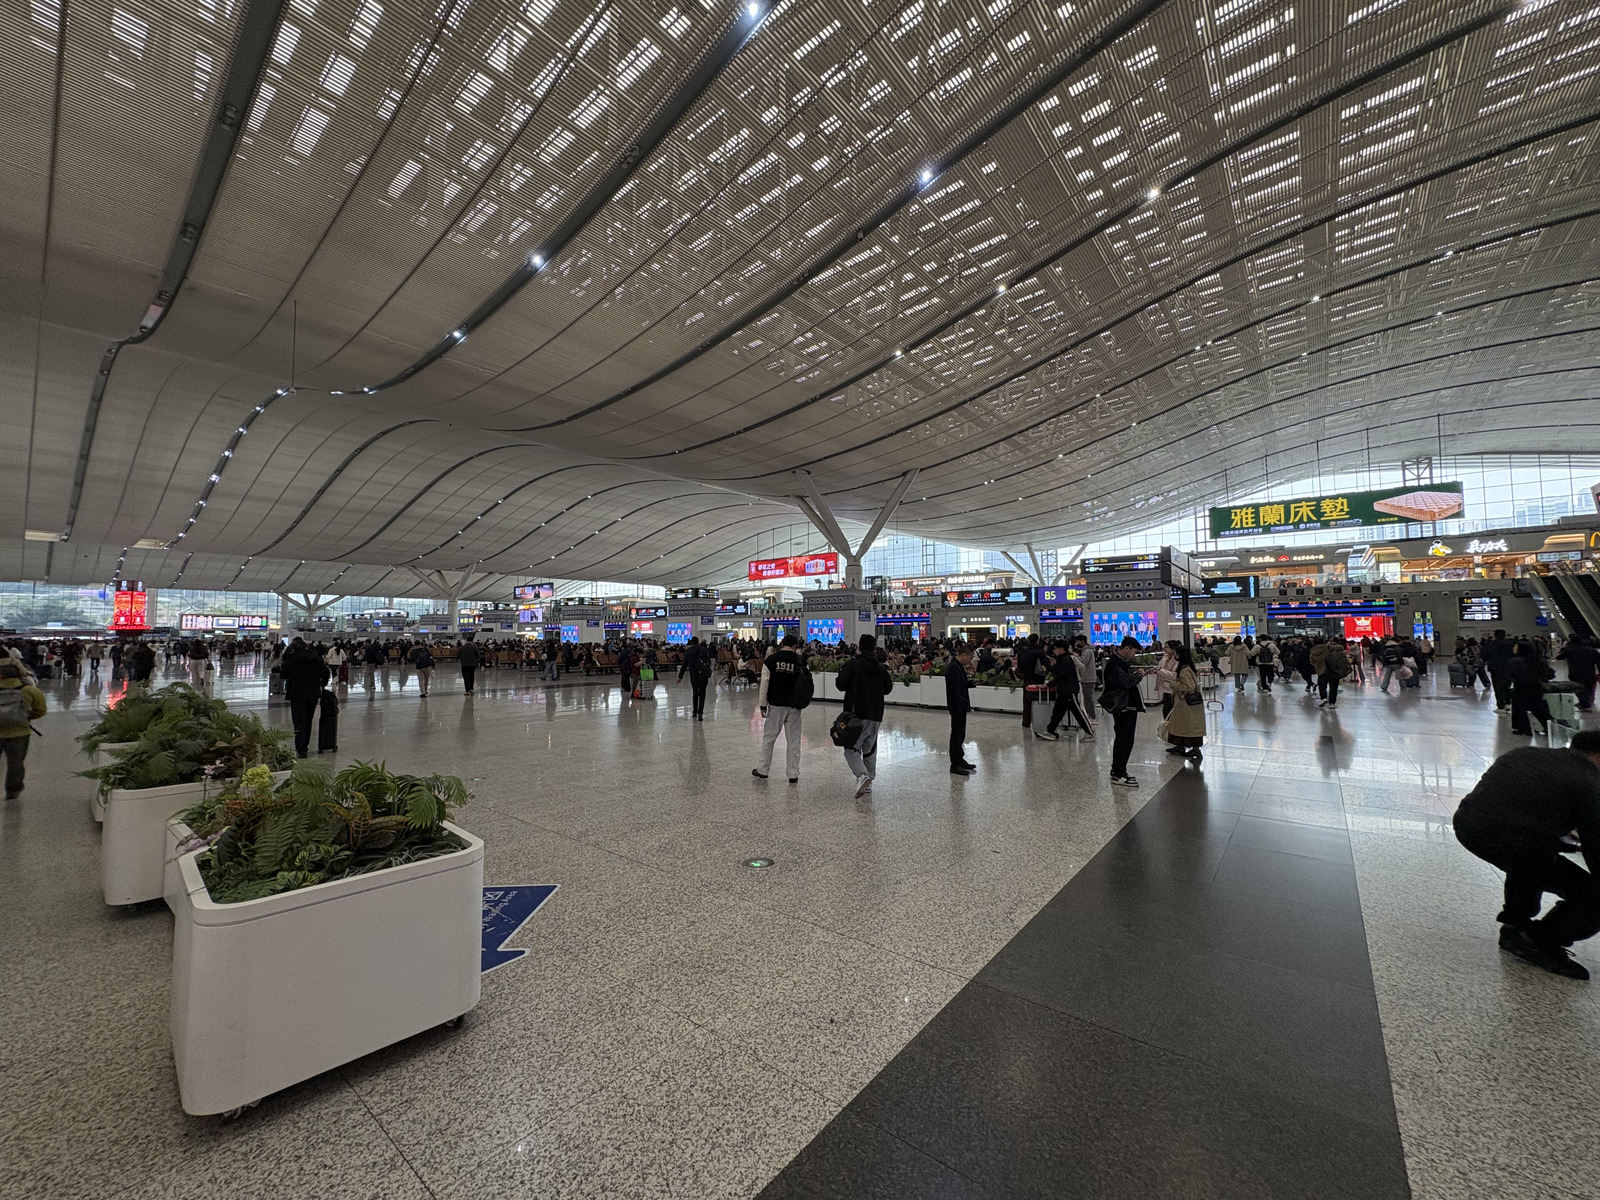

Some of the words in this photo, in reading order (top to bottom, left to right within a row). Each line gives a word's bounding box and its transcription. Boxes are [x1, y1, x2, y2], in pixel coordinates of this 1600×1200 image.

[1230, 497, 1350, 528] 雅蘭床墊
[1044, 590, 1057, 601] B5
[775, 661, 795, 672] 1911
